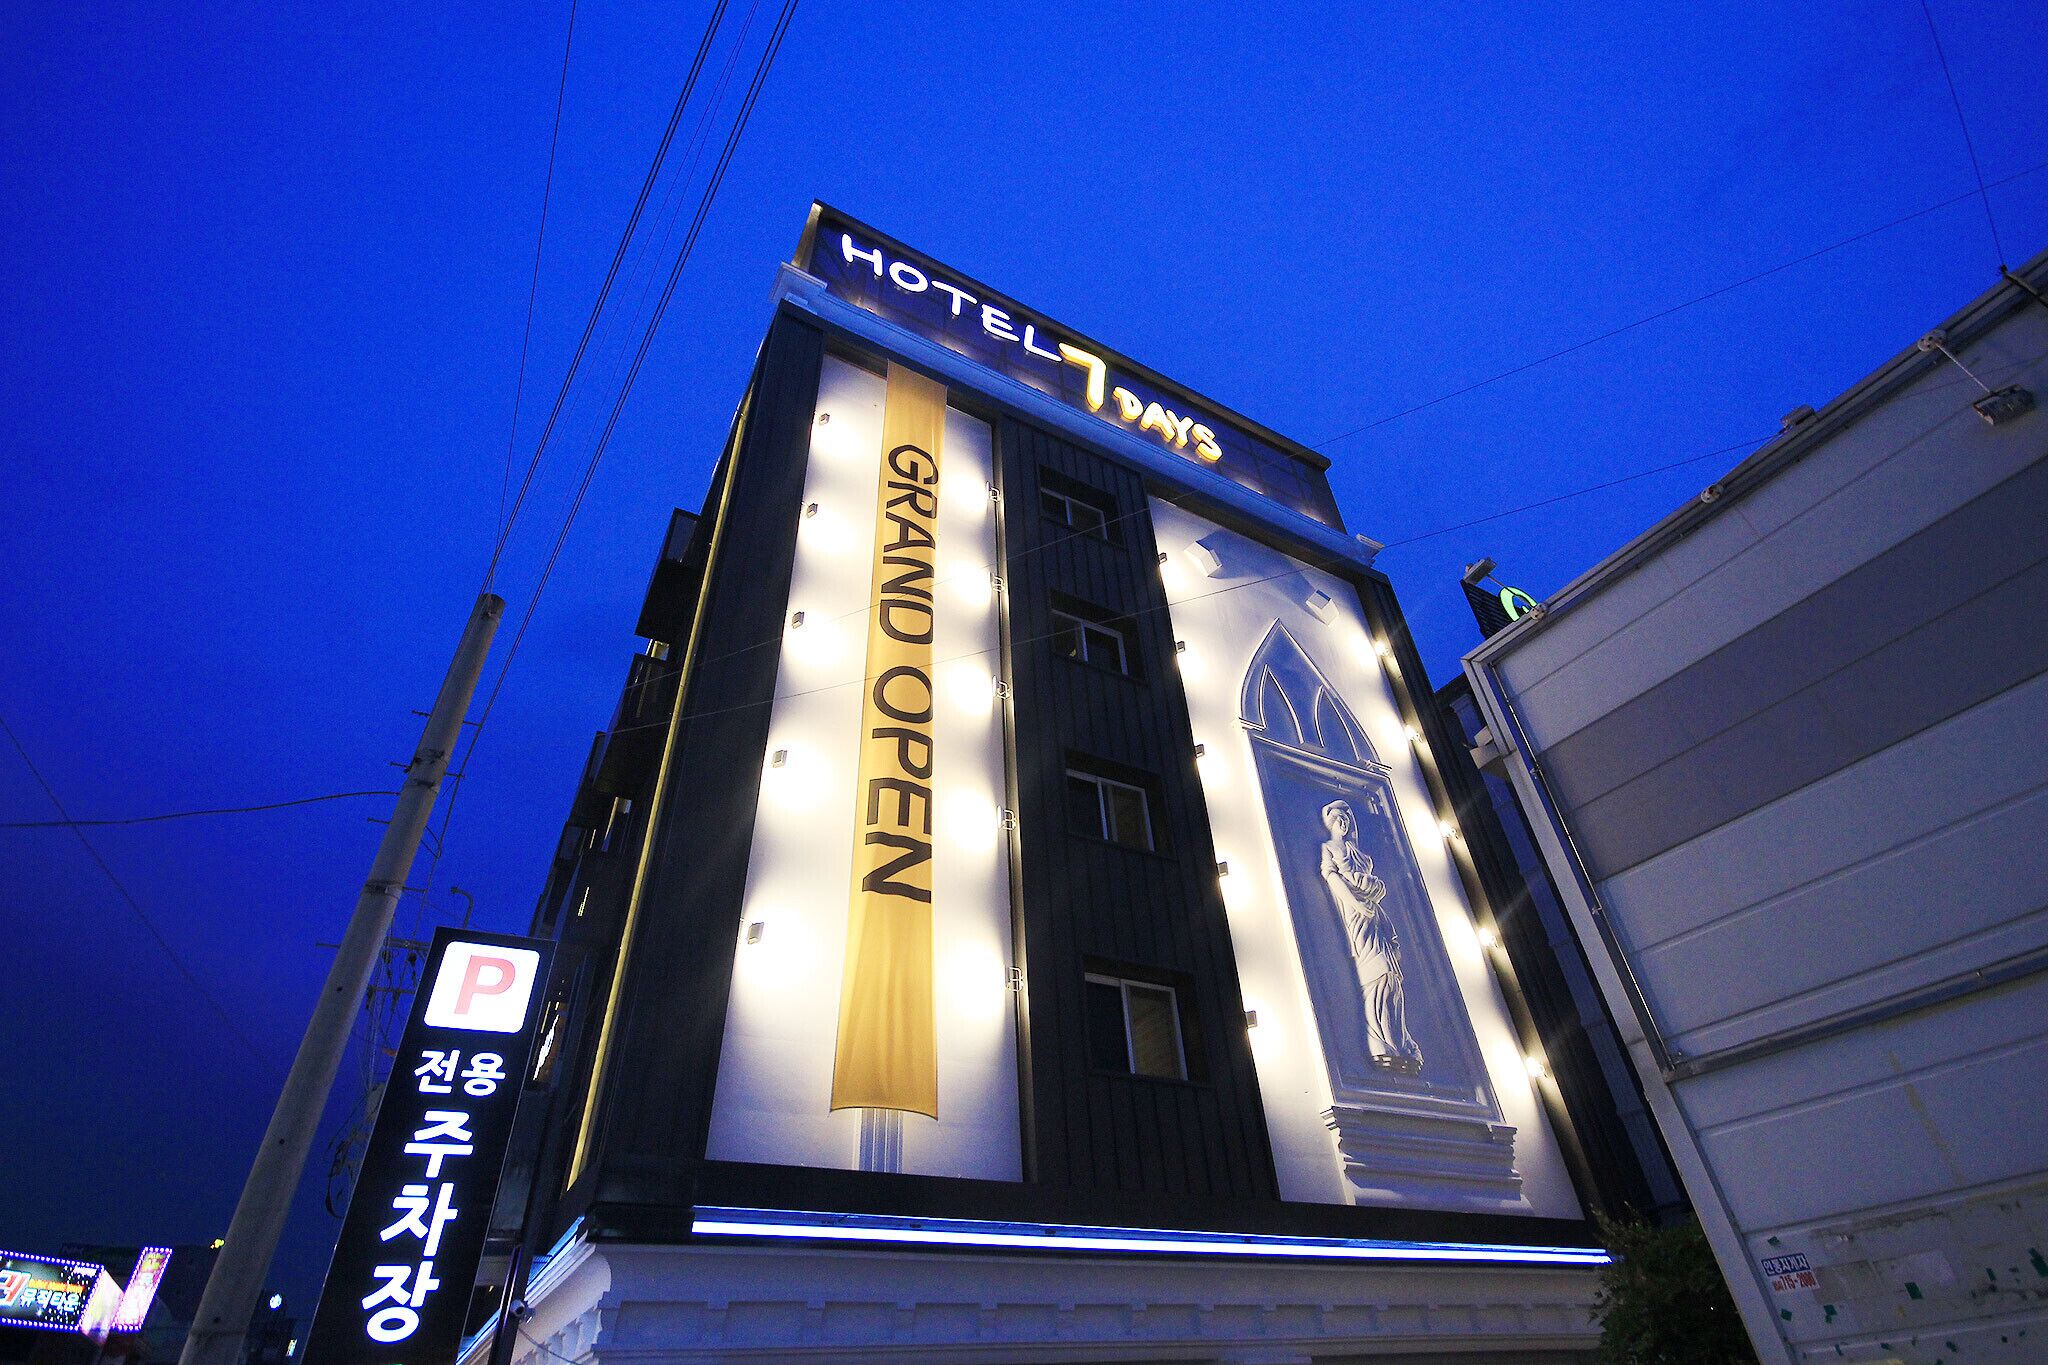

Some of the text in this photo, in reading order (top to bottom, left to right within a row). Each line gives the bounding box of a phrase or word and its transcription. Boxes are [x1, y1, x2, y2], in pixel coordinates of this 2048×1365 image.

[841, 233, 1223, 462] HOTEL 7 DAYS
[862, 444, 939, 904] GRAND OPEN
[414, 1049, 506, 1097] 전용
[454, 955, 516, 1015] P
[361, 1110, 474, 1343] 주차장
